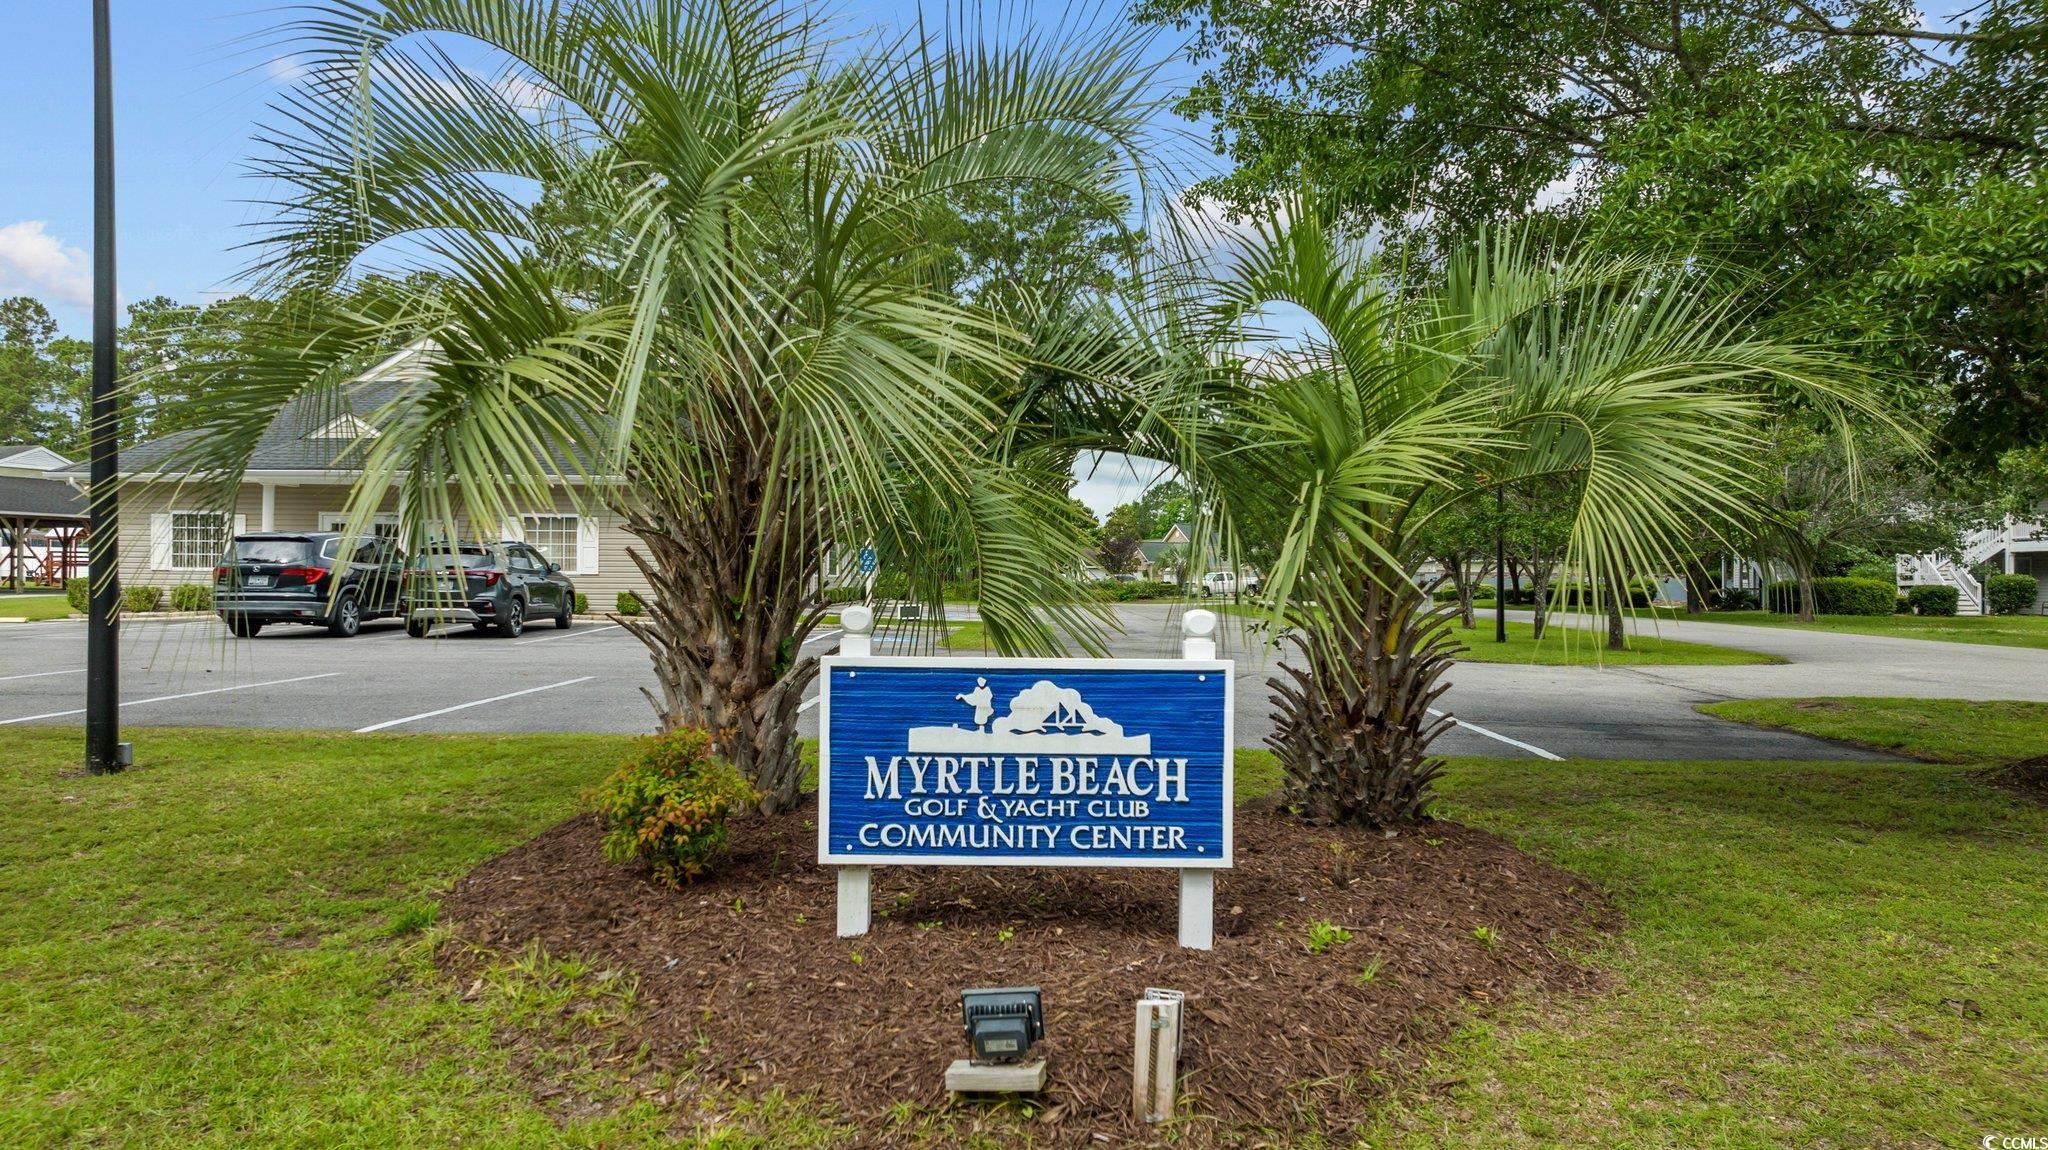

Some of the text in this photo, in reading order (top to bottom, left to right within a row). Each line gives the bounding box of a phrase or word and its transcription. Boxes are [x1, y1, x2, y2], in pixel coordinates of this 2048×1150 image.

[864, 756, 1190, 802] MYRTLE BEACH
[904, 795, 1150, 824] GOLF & YACHT CLUB
[858, 823, 1188, 850] COMMUNITY CENTER
